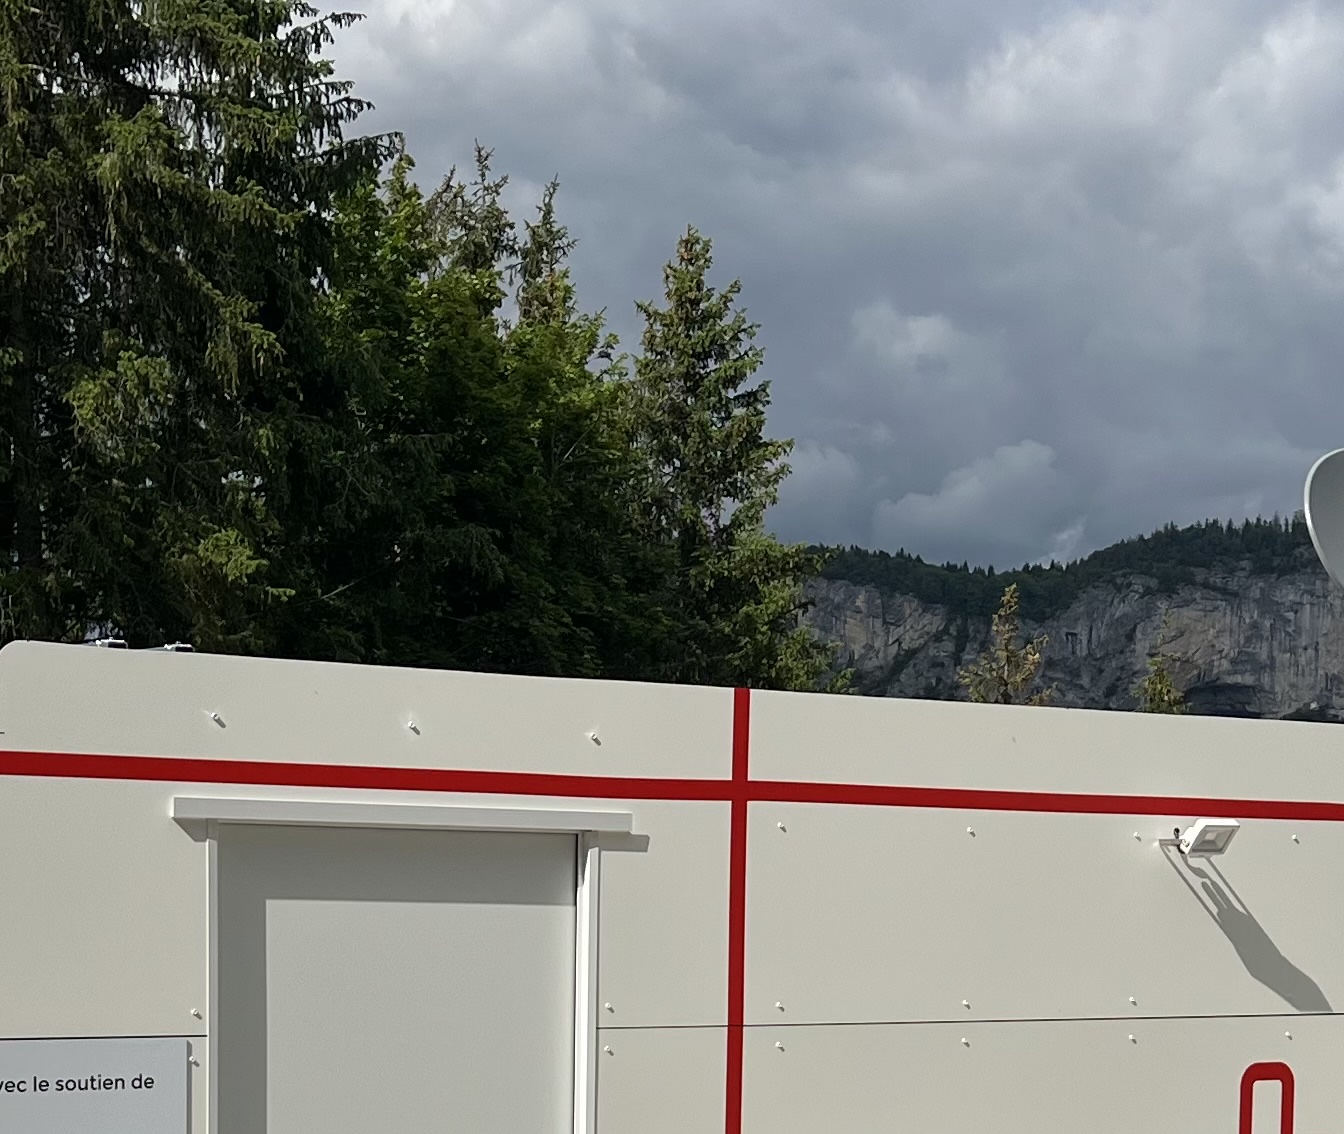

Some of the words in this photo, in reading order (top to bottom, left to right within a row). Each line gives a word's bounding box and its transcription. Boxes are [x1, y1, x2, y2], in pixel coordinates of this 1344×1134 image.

[33, 1075, 50, 1092] le
[55, 1073, 126, 1092] soutien
[131, 1073, 155, 1090] de
